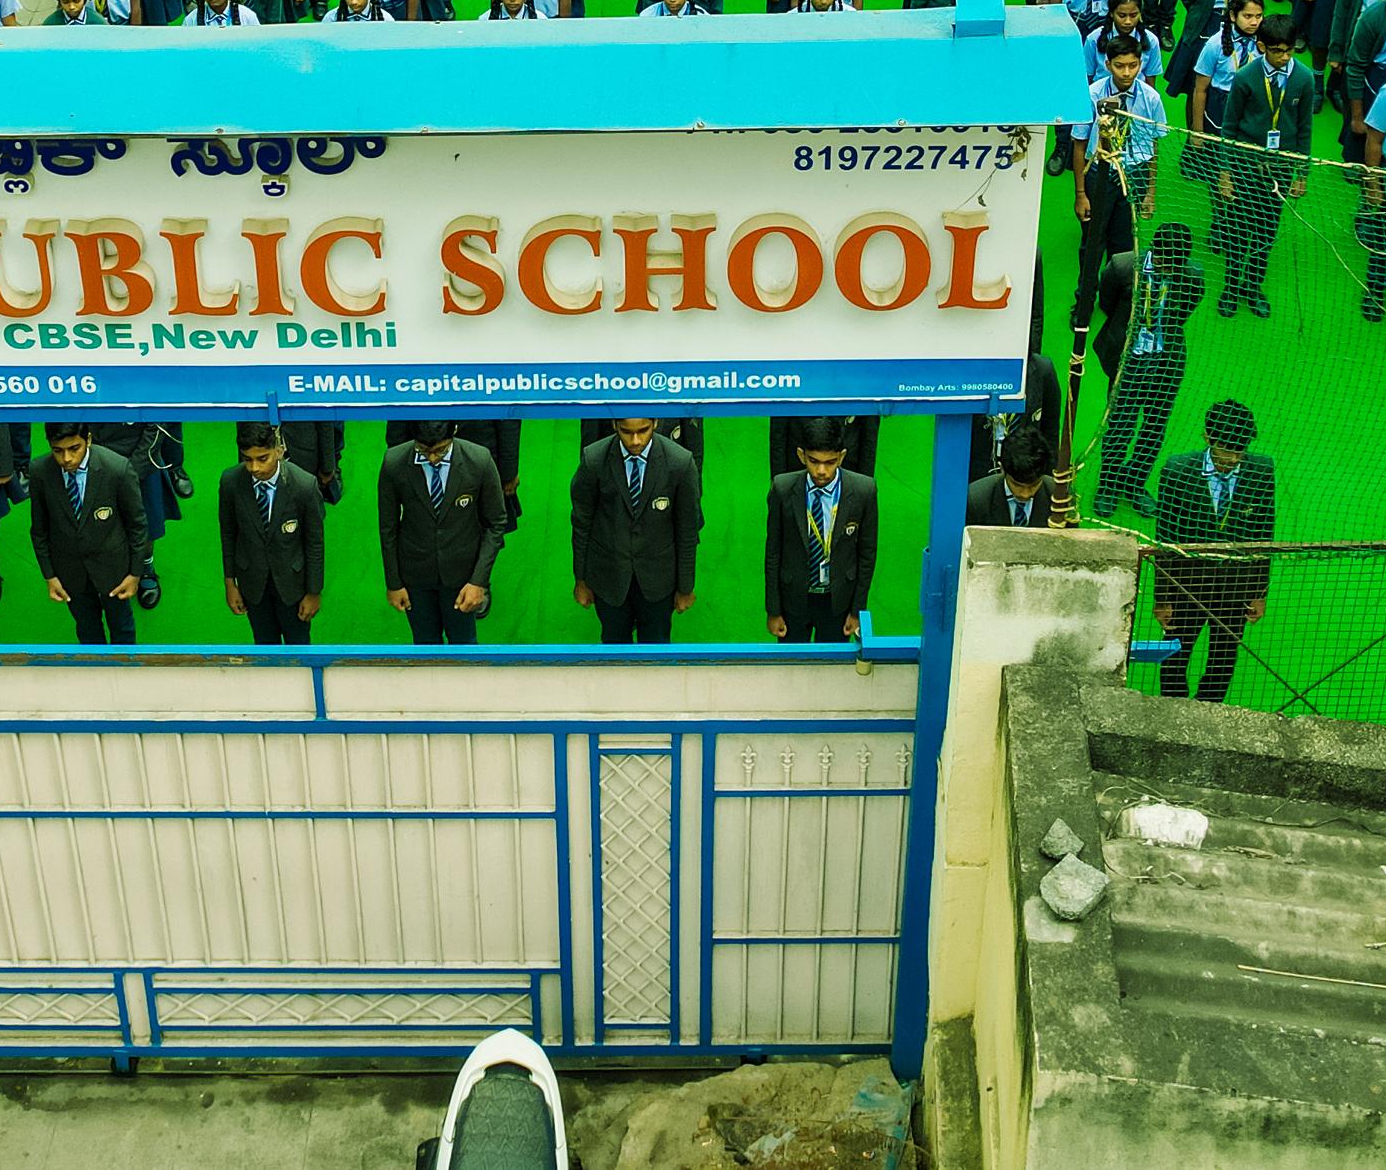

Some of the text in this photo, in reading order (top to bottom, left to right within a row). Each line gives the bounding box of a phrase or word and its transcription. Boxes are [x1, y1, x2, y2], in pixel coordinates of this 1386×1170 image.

[793, 145, 1014, 171] 8197227475
[440, 224, 1013, 316] SCHOOL
[276, 321, 397, 348] Delhi
[48, 376, 97, 394] 016
[288, 372, 801, 395] E-MAIL: capitalpublicschool@gmail.com
[898, 384, 935, 393] Bombay
